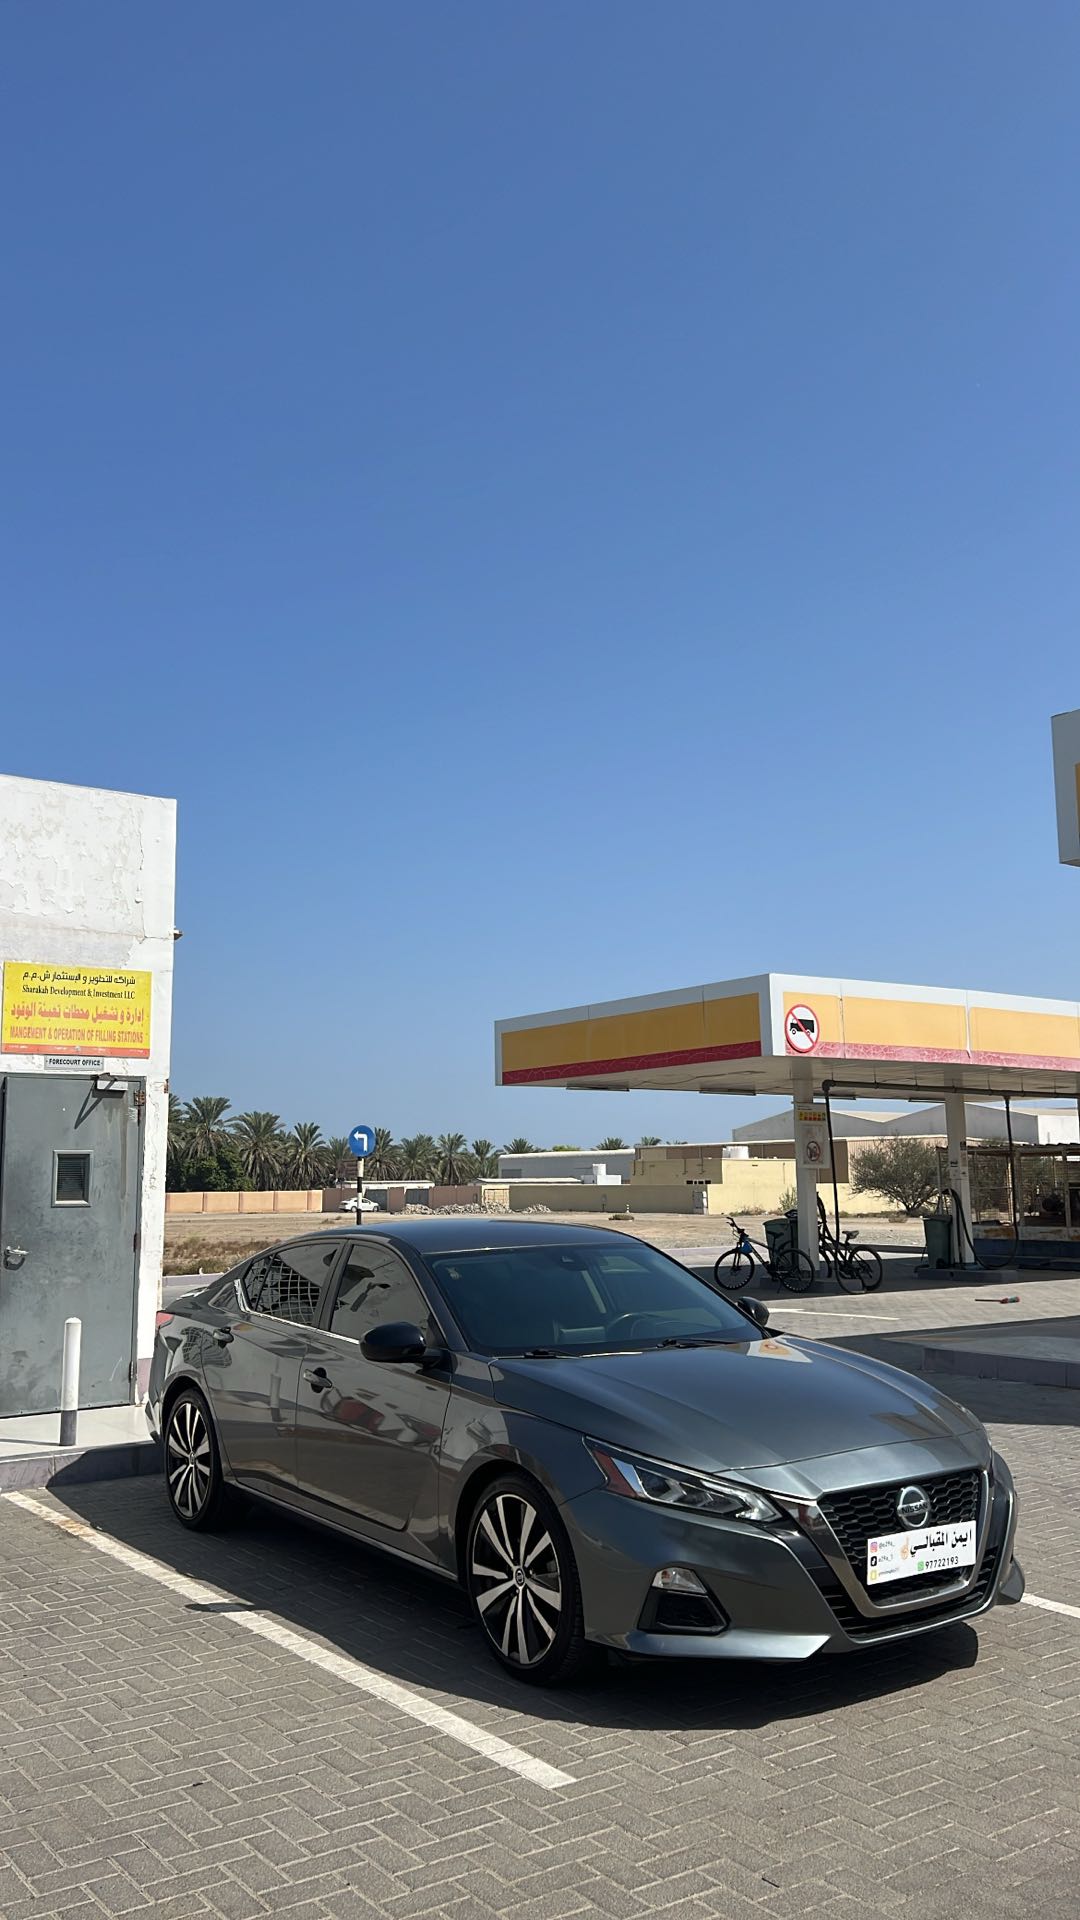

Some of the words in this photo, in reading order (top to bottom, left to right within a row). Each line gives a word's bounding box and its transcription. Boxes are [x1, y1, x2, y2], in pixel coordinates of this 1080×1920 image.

[82, 976, 88, 984] و
[22, 984, 48, 994] Sharakah
[50, 986, 86, 998] Development
[88, 989, 93, 998] &
[93, 989, 123, 998] Investment
[125, 991, 136, 999] LLC
[11, 1001, 36, 1020] الوقود
[63, 1004, 90, 1020] محطات
[92, 1006, 118, 1024] تشغيل
[120, 1010, 124, 1024] و
[48, 1027, 52, 1040] &
[54, 1028, 86, 1040] OPERATION
[87, 1030, 94, 1041] OF
[96, 1030, 116, 1042] FILLING
[118, 1031, 143, 1043] STATIONS
[902, 1503, 928, 1514] NISSAN
[925, 1556, 958, 1569] 97722193
